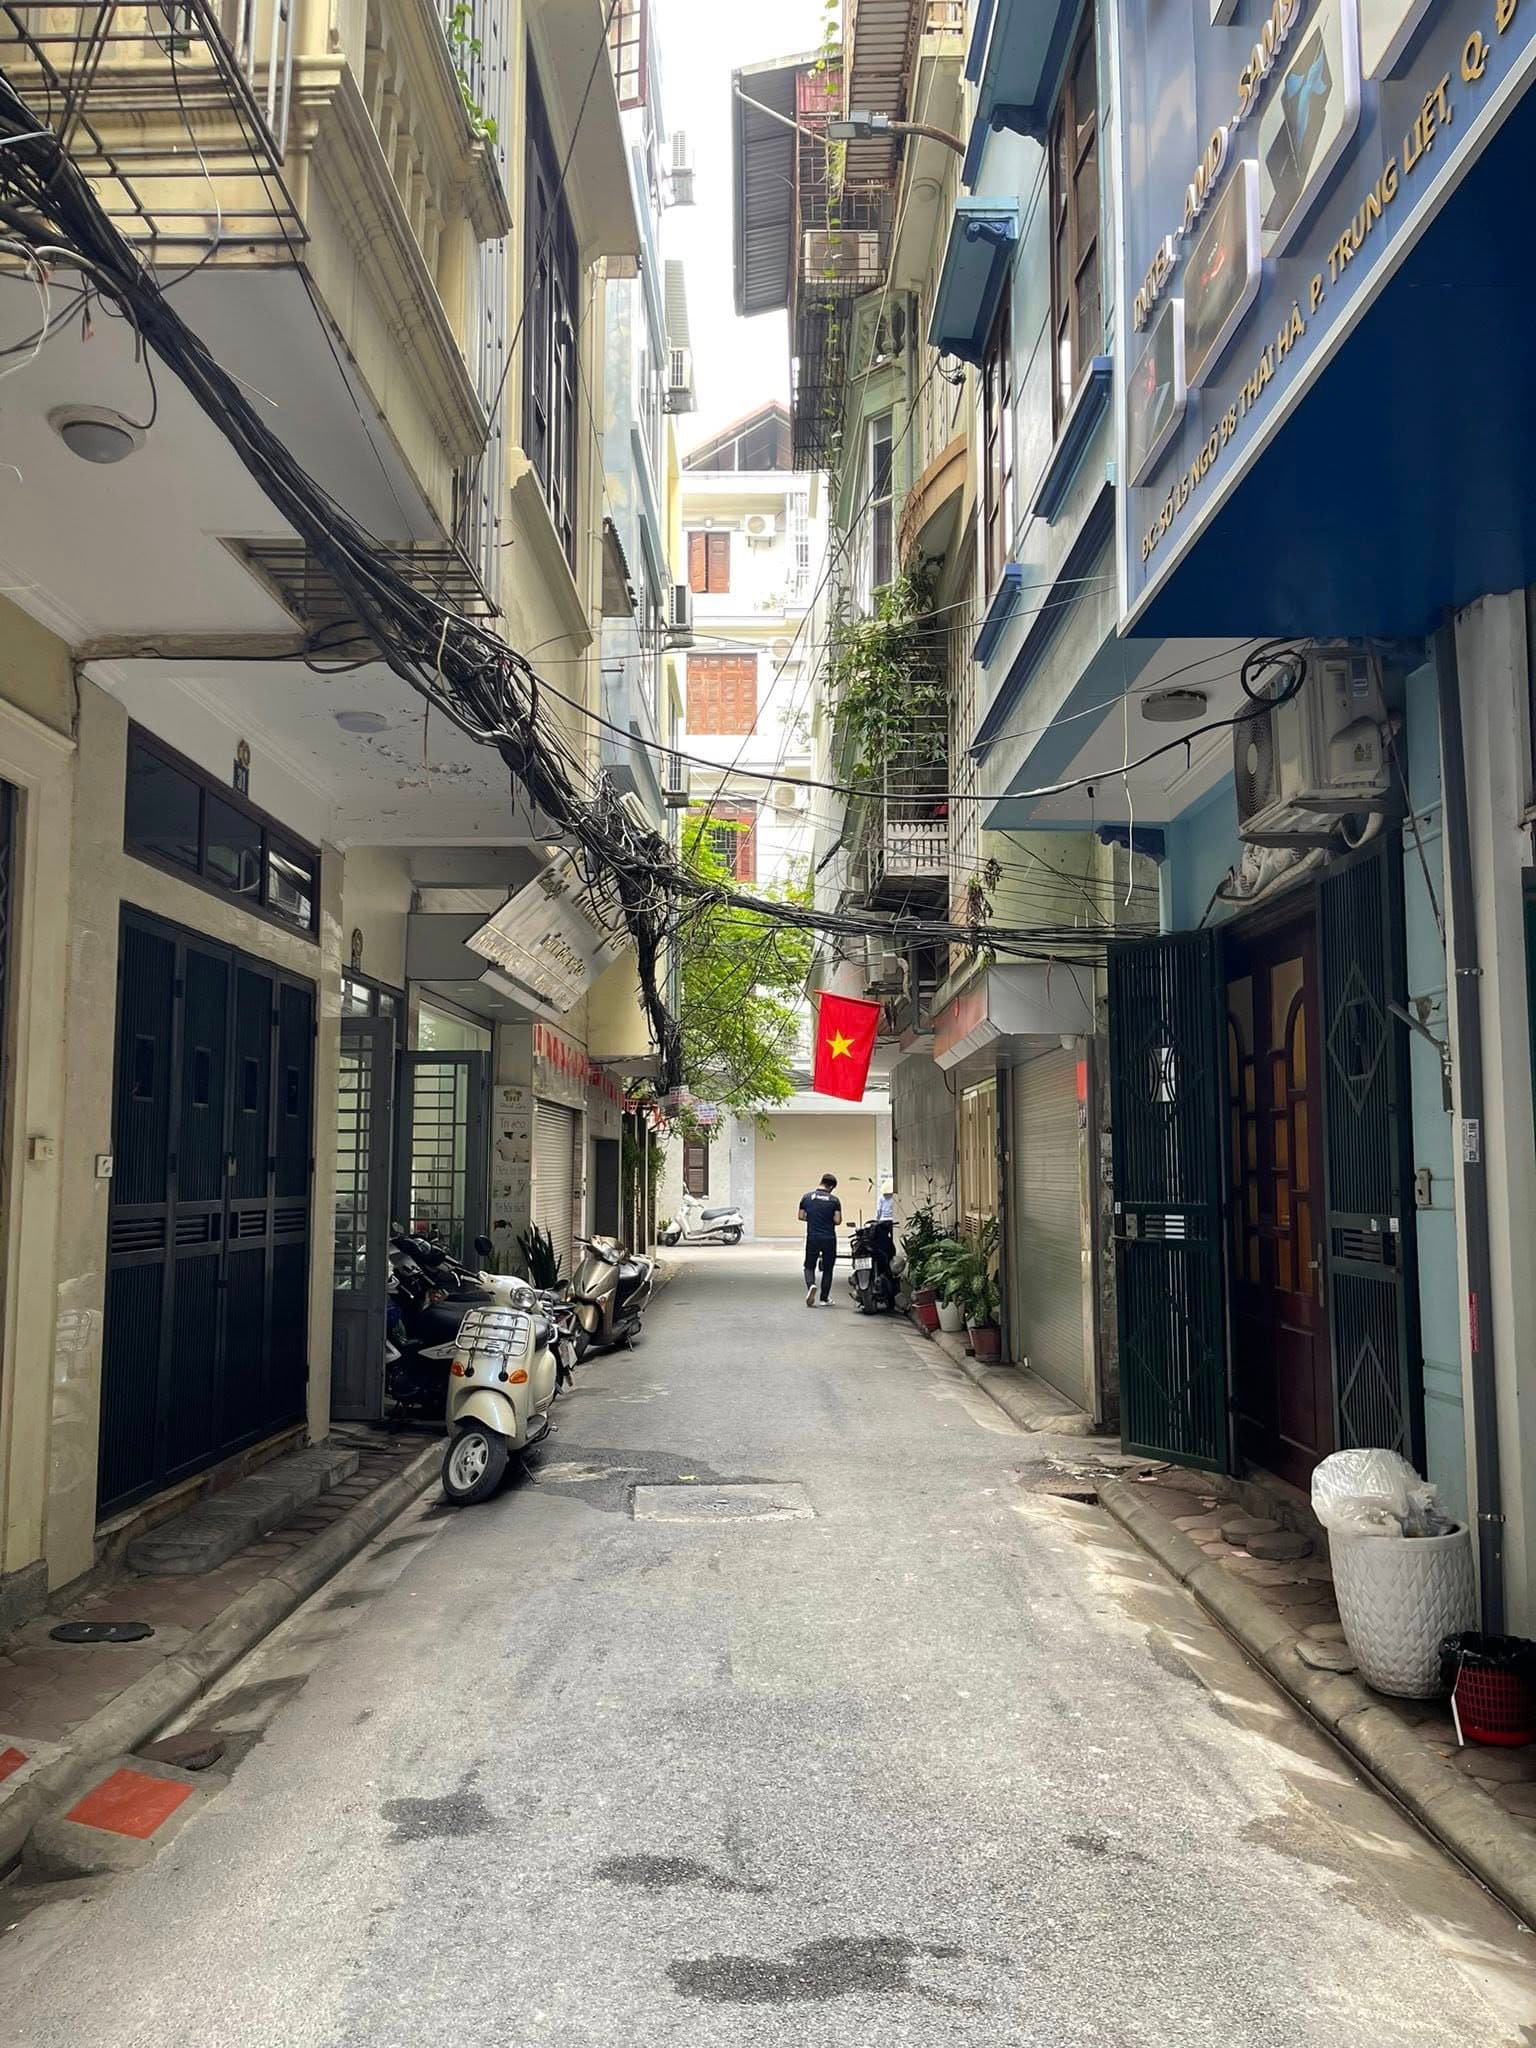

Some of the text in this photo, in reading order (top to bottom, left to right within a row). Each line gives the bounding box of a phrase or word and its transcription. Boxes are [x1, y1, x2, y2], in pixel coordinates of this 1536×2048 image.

[1176, 474, 1190, 514] 15
[1191, 424, 1218, 491] NGÕ
[1221, 403, 1237, 447] 98
[1239, 345, 1275, 418] THÁI
[1310, 273, 1325, 315] P.
[1327, 156, 1398, 285] TRUNG
[1461, 31, 1490, 82] Q.
[1183, 126, 1228, 233] AMD
